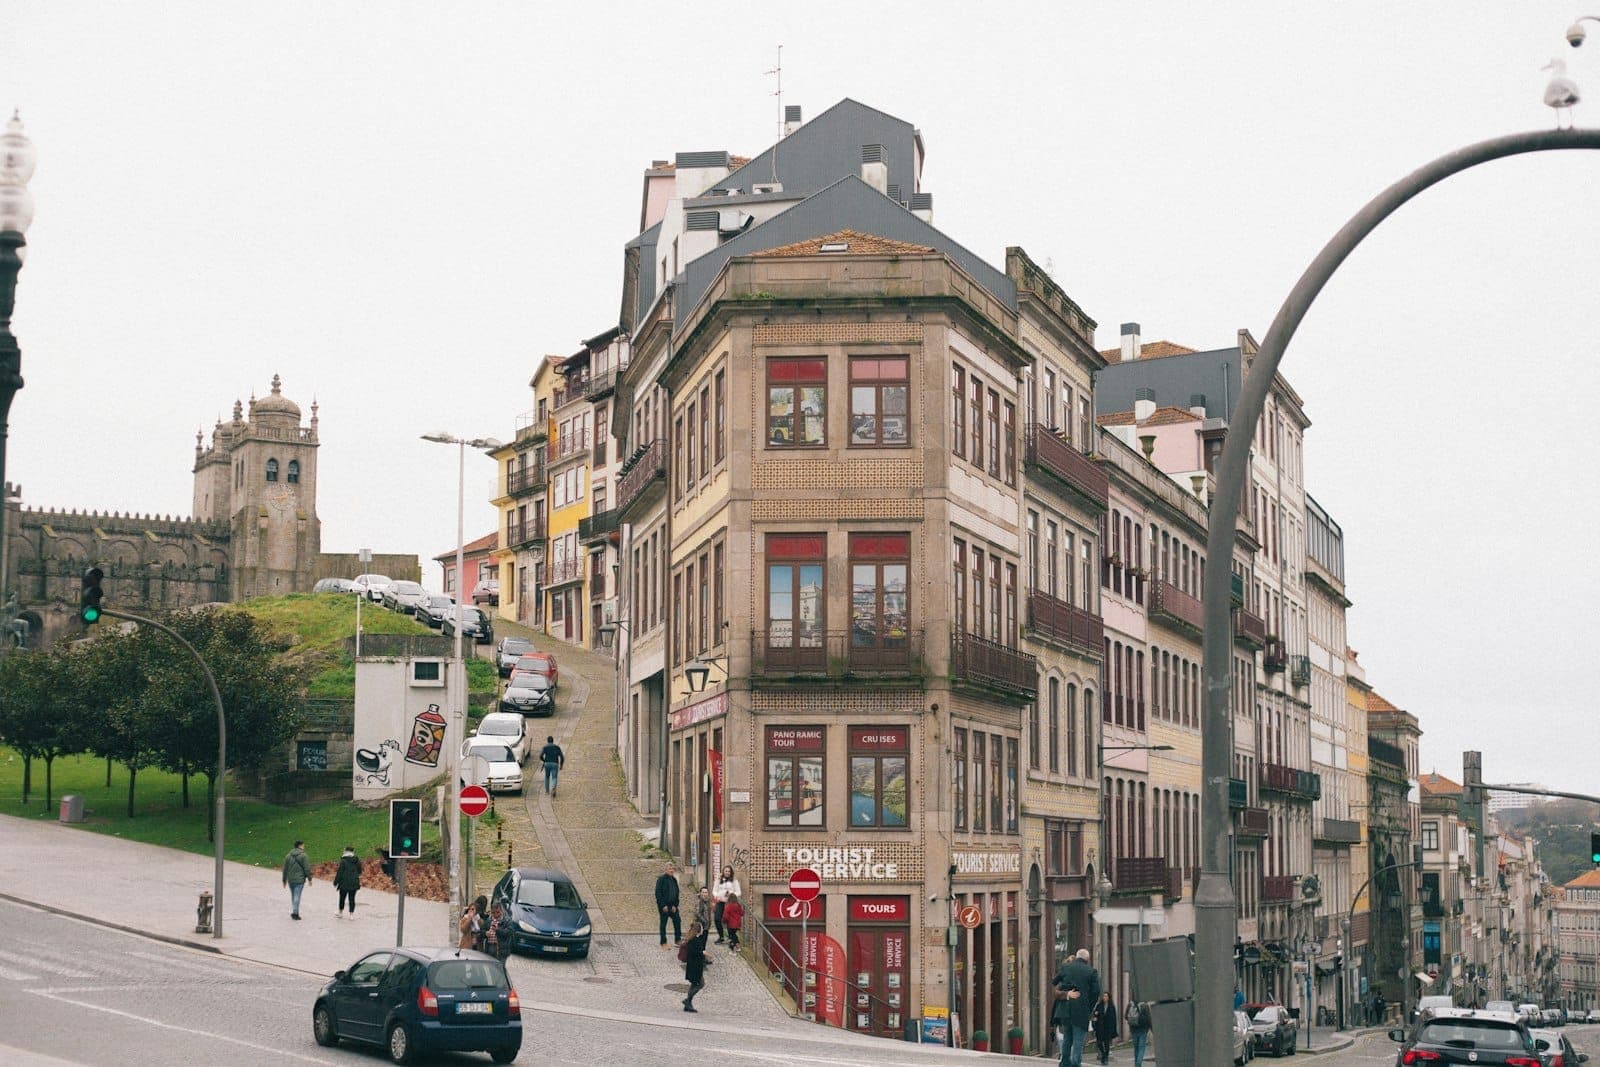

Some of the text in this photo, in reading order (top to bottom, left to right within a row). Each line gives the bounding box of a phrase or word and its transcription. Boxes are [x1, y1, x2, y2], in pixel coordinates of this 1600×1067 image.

[773, 739, 795, 747] TOUR
[783, 848, 875, 864] TOURIST
[952, 853, 1020, 872] TOURIST SERVICE
[810, 863, 897, 878] SERVICE
[862, 904, 896, 914] TOURS
[886, 937, 894, 968] TOURIST
[894, 937, 902, 968] SERVICE
